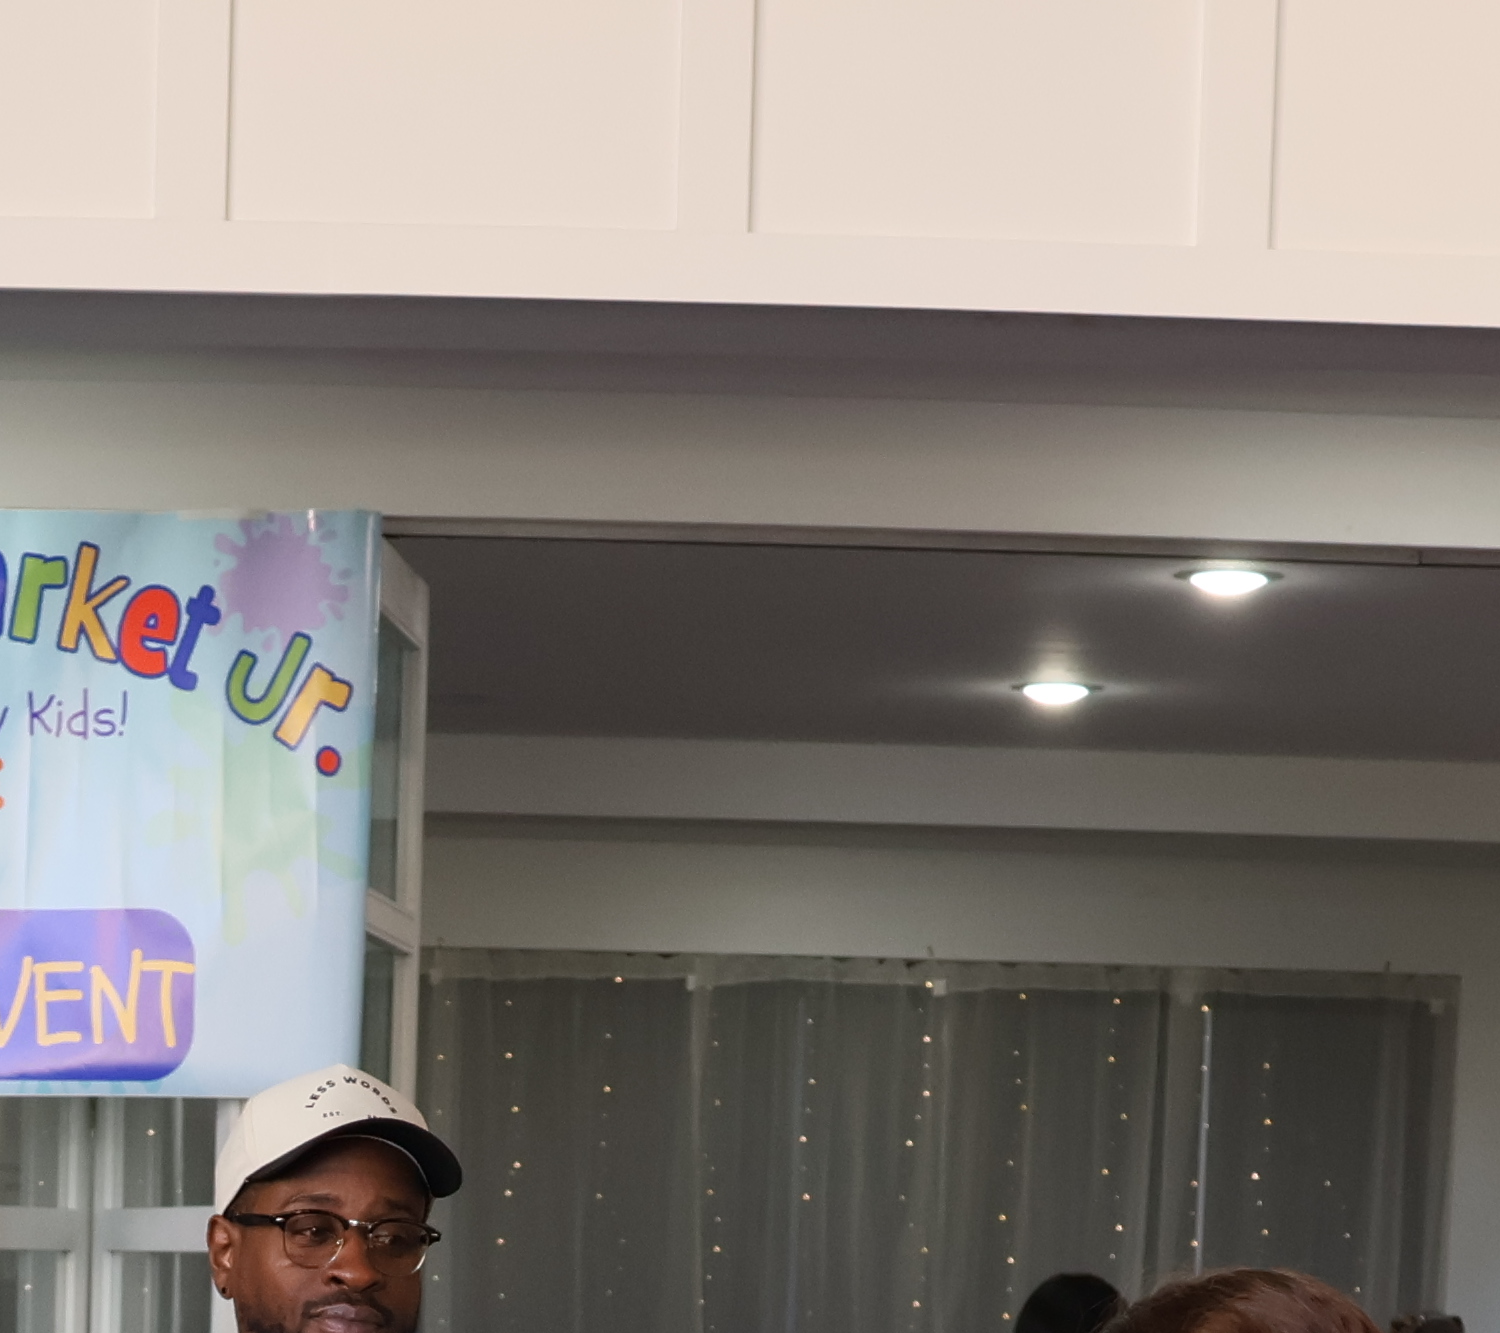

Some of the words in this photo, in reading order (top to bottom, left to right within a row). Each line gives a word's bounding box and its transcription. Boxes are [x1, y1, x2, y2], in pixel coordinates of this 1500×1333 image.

[27, 687, 128, 740] Kids!
[225, 631, 353, 776] Jr.
[305, 1079, 336, 1108] LESS
